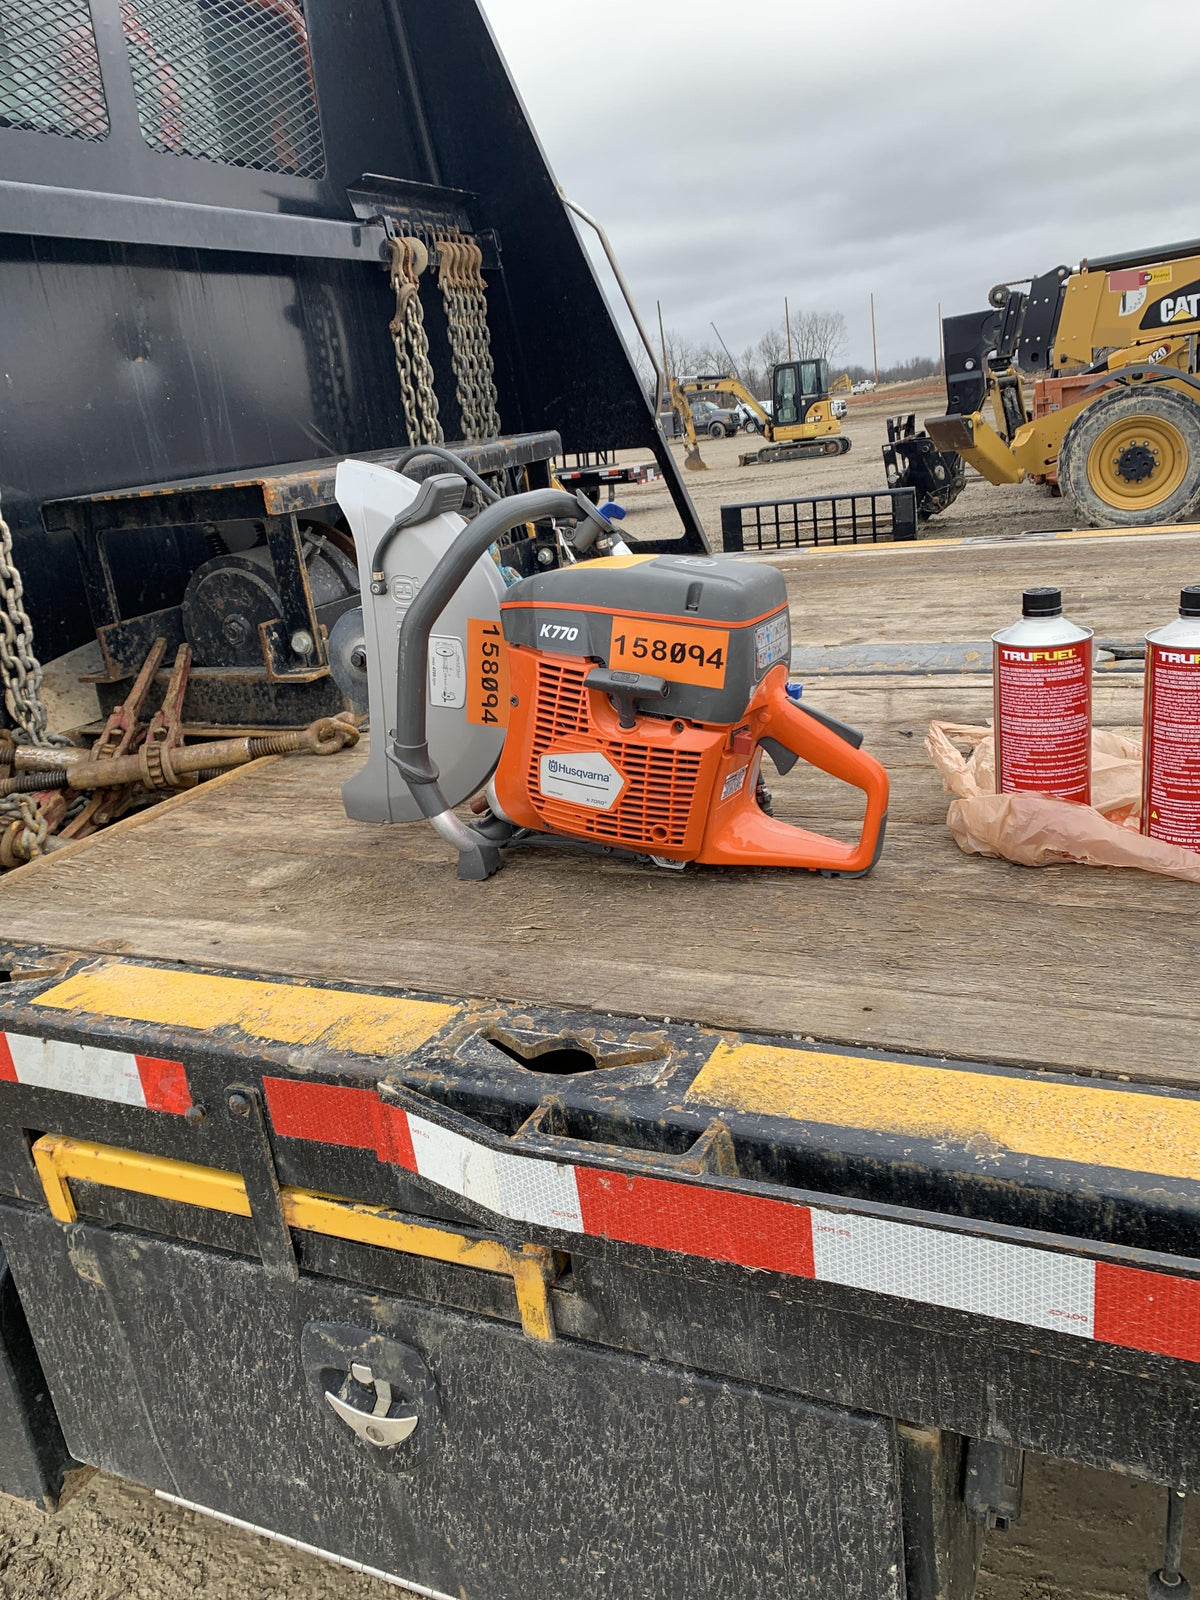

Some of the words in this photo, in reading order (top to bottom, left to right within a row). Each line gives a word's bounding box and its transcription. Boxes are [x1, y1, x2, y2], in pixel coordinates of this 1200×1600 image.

[1160, 292, 1200, 323] CAT
[539, 623, 579, 642] K770
[614, 634, 724, 670] 158094
[1002, 648, 1077, 662] TRUFUEL
[481, 624, 500, 724] 158094
[558, 763, 610, 783] Husqvarna
